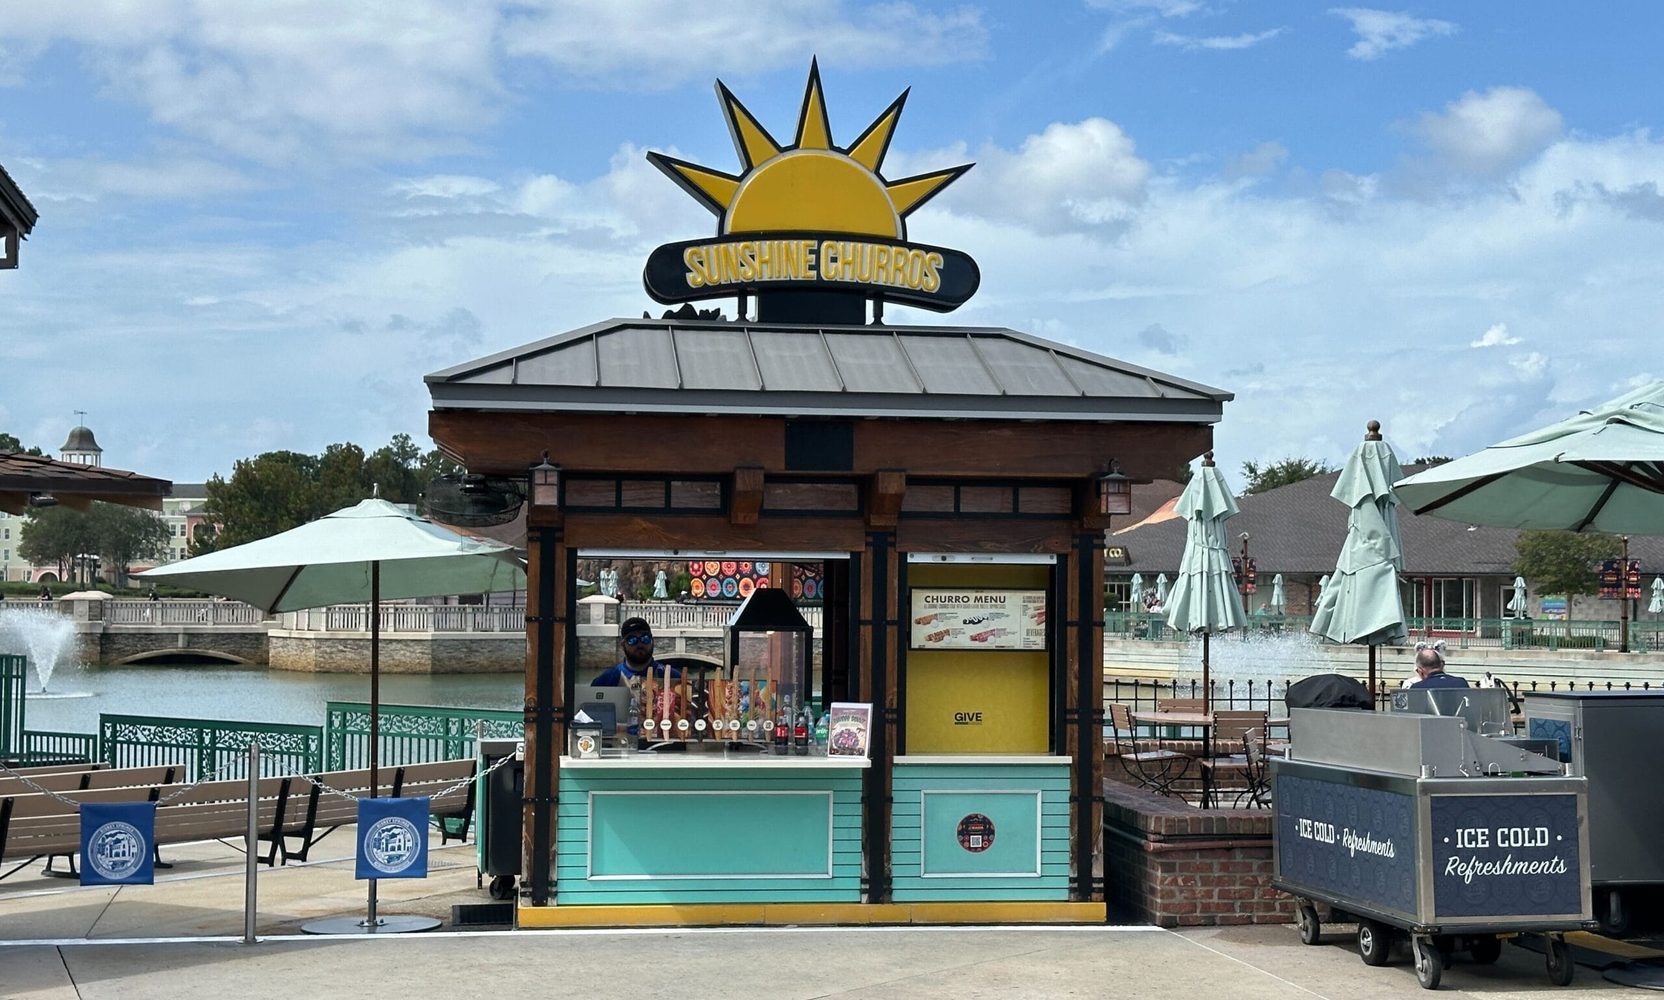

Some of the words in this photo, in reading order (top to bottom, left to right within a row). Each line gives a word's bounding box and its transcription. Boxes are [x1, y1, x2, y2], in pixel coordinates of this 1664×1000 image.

[683, 240, 818, 289] SUNSHINE
[819, 240, 944, 293] CHURROS
[924, 595, 970, 604] CHURRO
[973, 595, 1006, 604] MENU
[954, 712, 983, 722] GIVE
[1299, 818, 1313, 839] ICE
[1314, 821, 1335, 844] COLD
[1342, 828, 1395, 858] Refreshments
[1455, 828, 1490, 848] ICE
[1497, 827, 1549, 848] COLD
[1444, 854, 1568, 885] Refreshments
